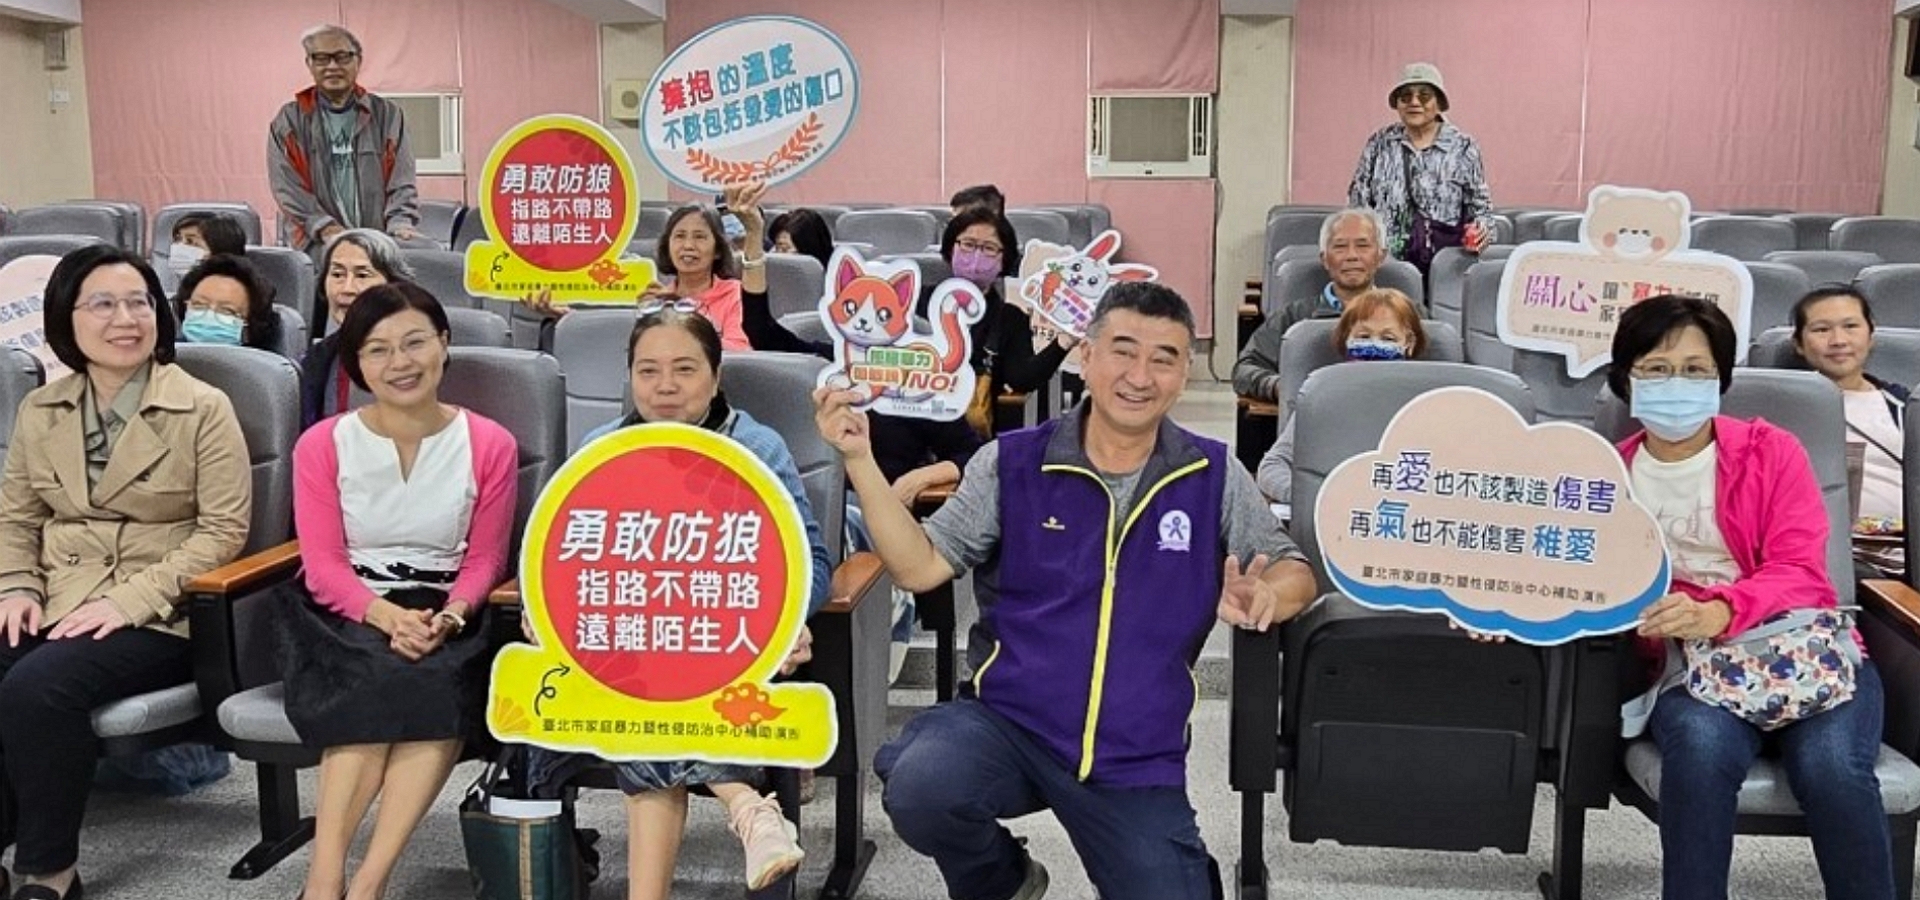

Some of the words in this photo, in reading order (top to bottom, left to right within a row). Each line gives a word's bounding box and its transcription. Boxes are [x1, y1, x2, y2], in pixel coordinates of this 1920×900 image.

[499, 162, 613, 195] 勇敢防狼
[510, 198, 613, 220] 指路不帶路
[510, 223, 613, 246] 遠離陌生人
[1523, 274, 1599, 314] 關心
[908, 372, 958, 392] NO!
[558, 508, 763, 563] 勇敢防狼
[576, 569, 761, 610] 指路不帶路
[576, 612, 760, 655] 遠離陌生人
